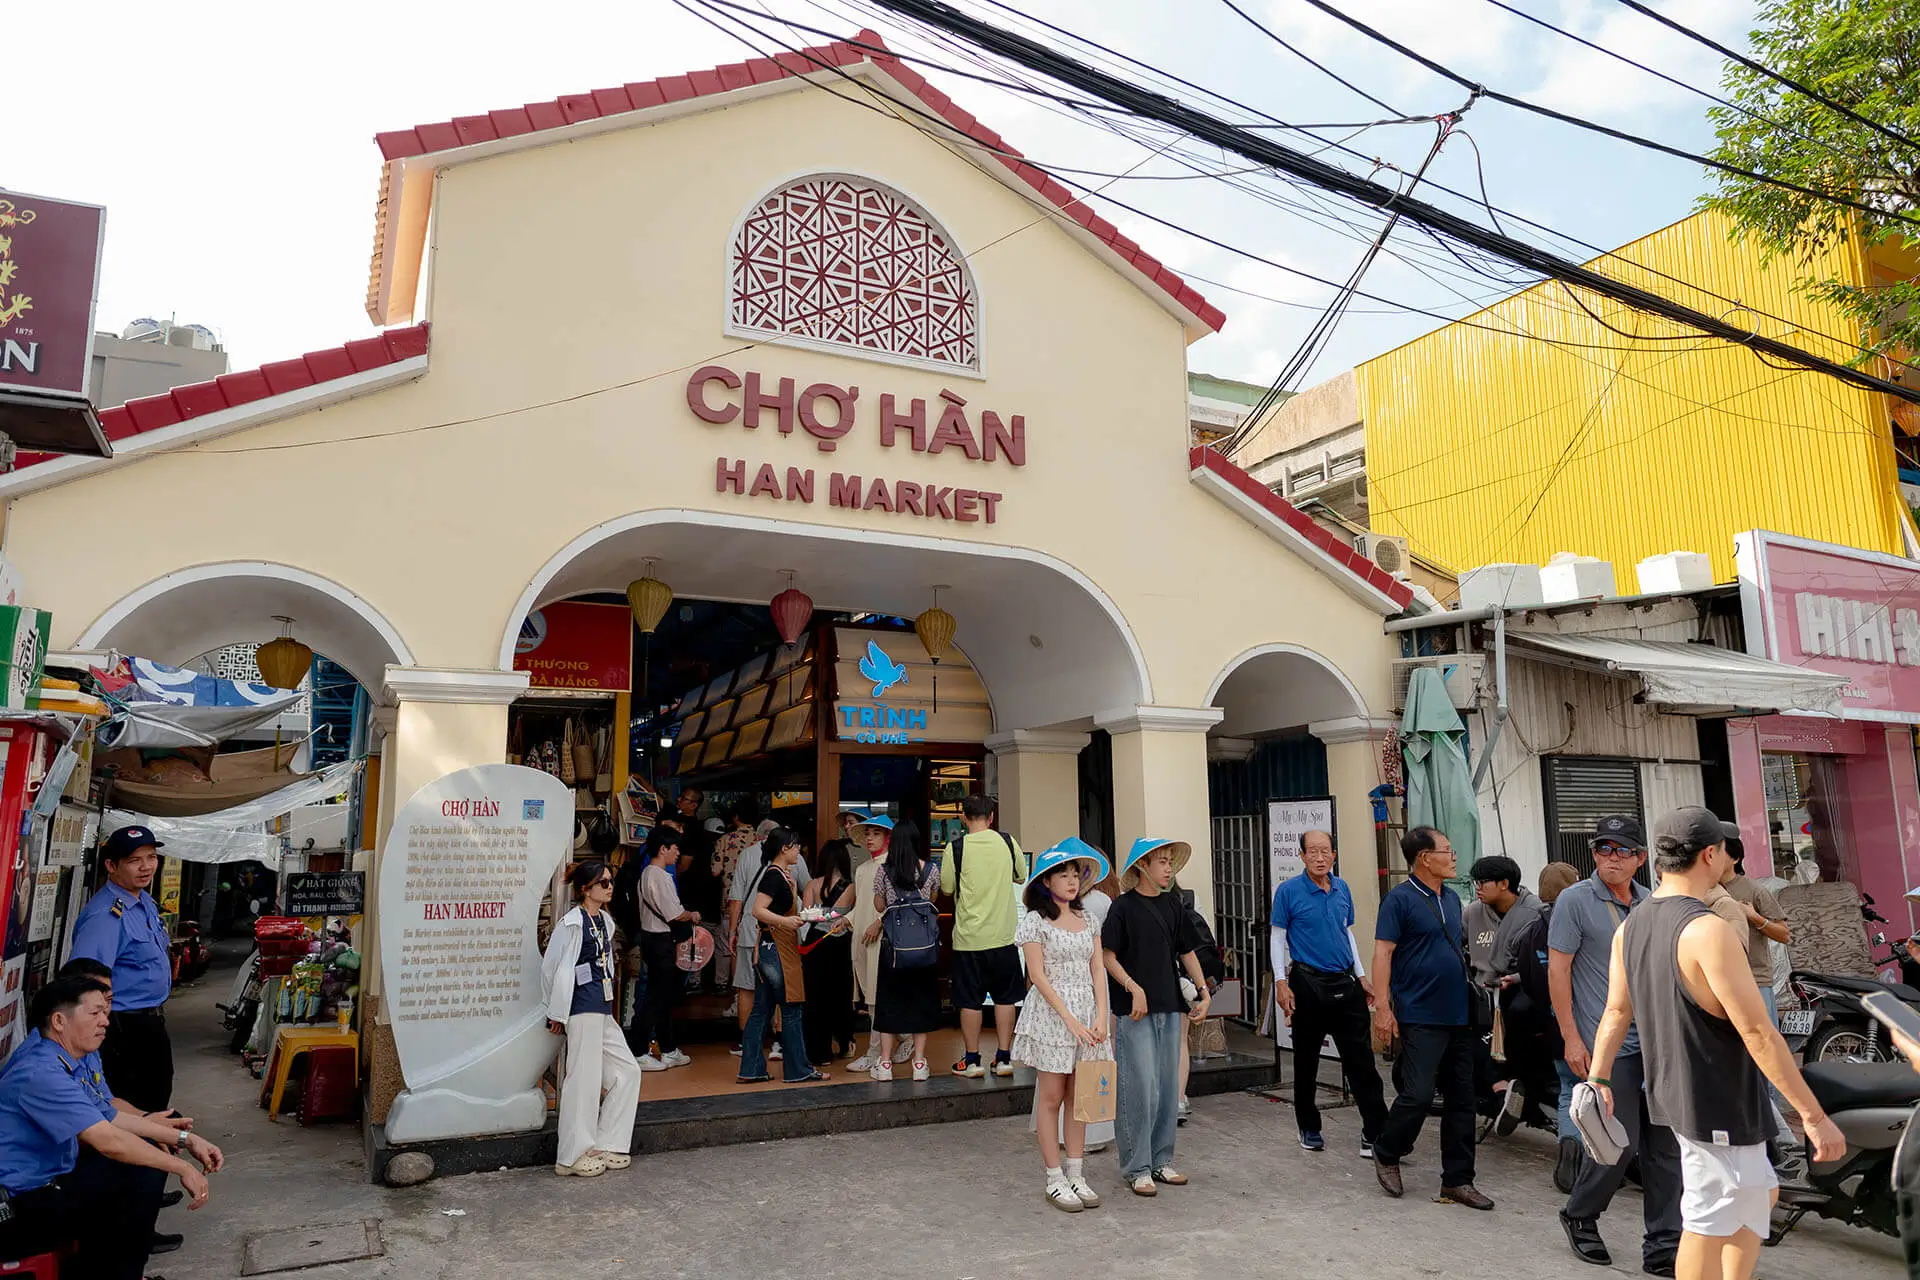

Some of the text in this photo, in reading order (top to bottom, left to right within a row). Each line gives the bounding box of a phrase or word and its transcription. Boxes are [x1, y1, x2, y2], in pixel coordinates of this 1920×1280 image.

[0, 338, 39, 373] N
[686, 366, 1026, 466] CHỢ HÀN
[716, 457, 1002, 524] HAN MARKET
[839, 702, 926, 729] TRÌNH
[441, 796, 501, 820] CHỢ HÀN
[424, 901, 506, 920] HAN MARKET
